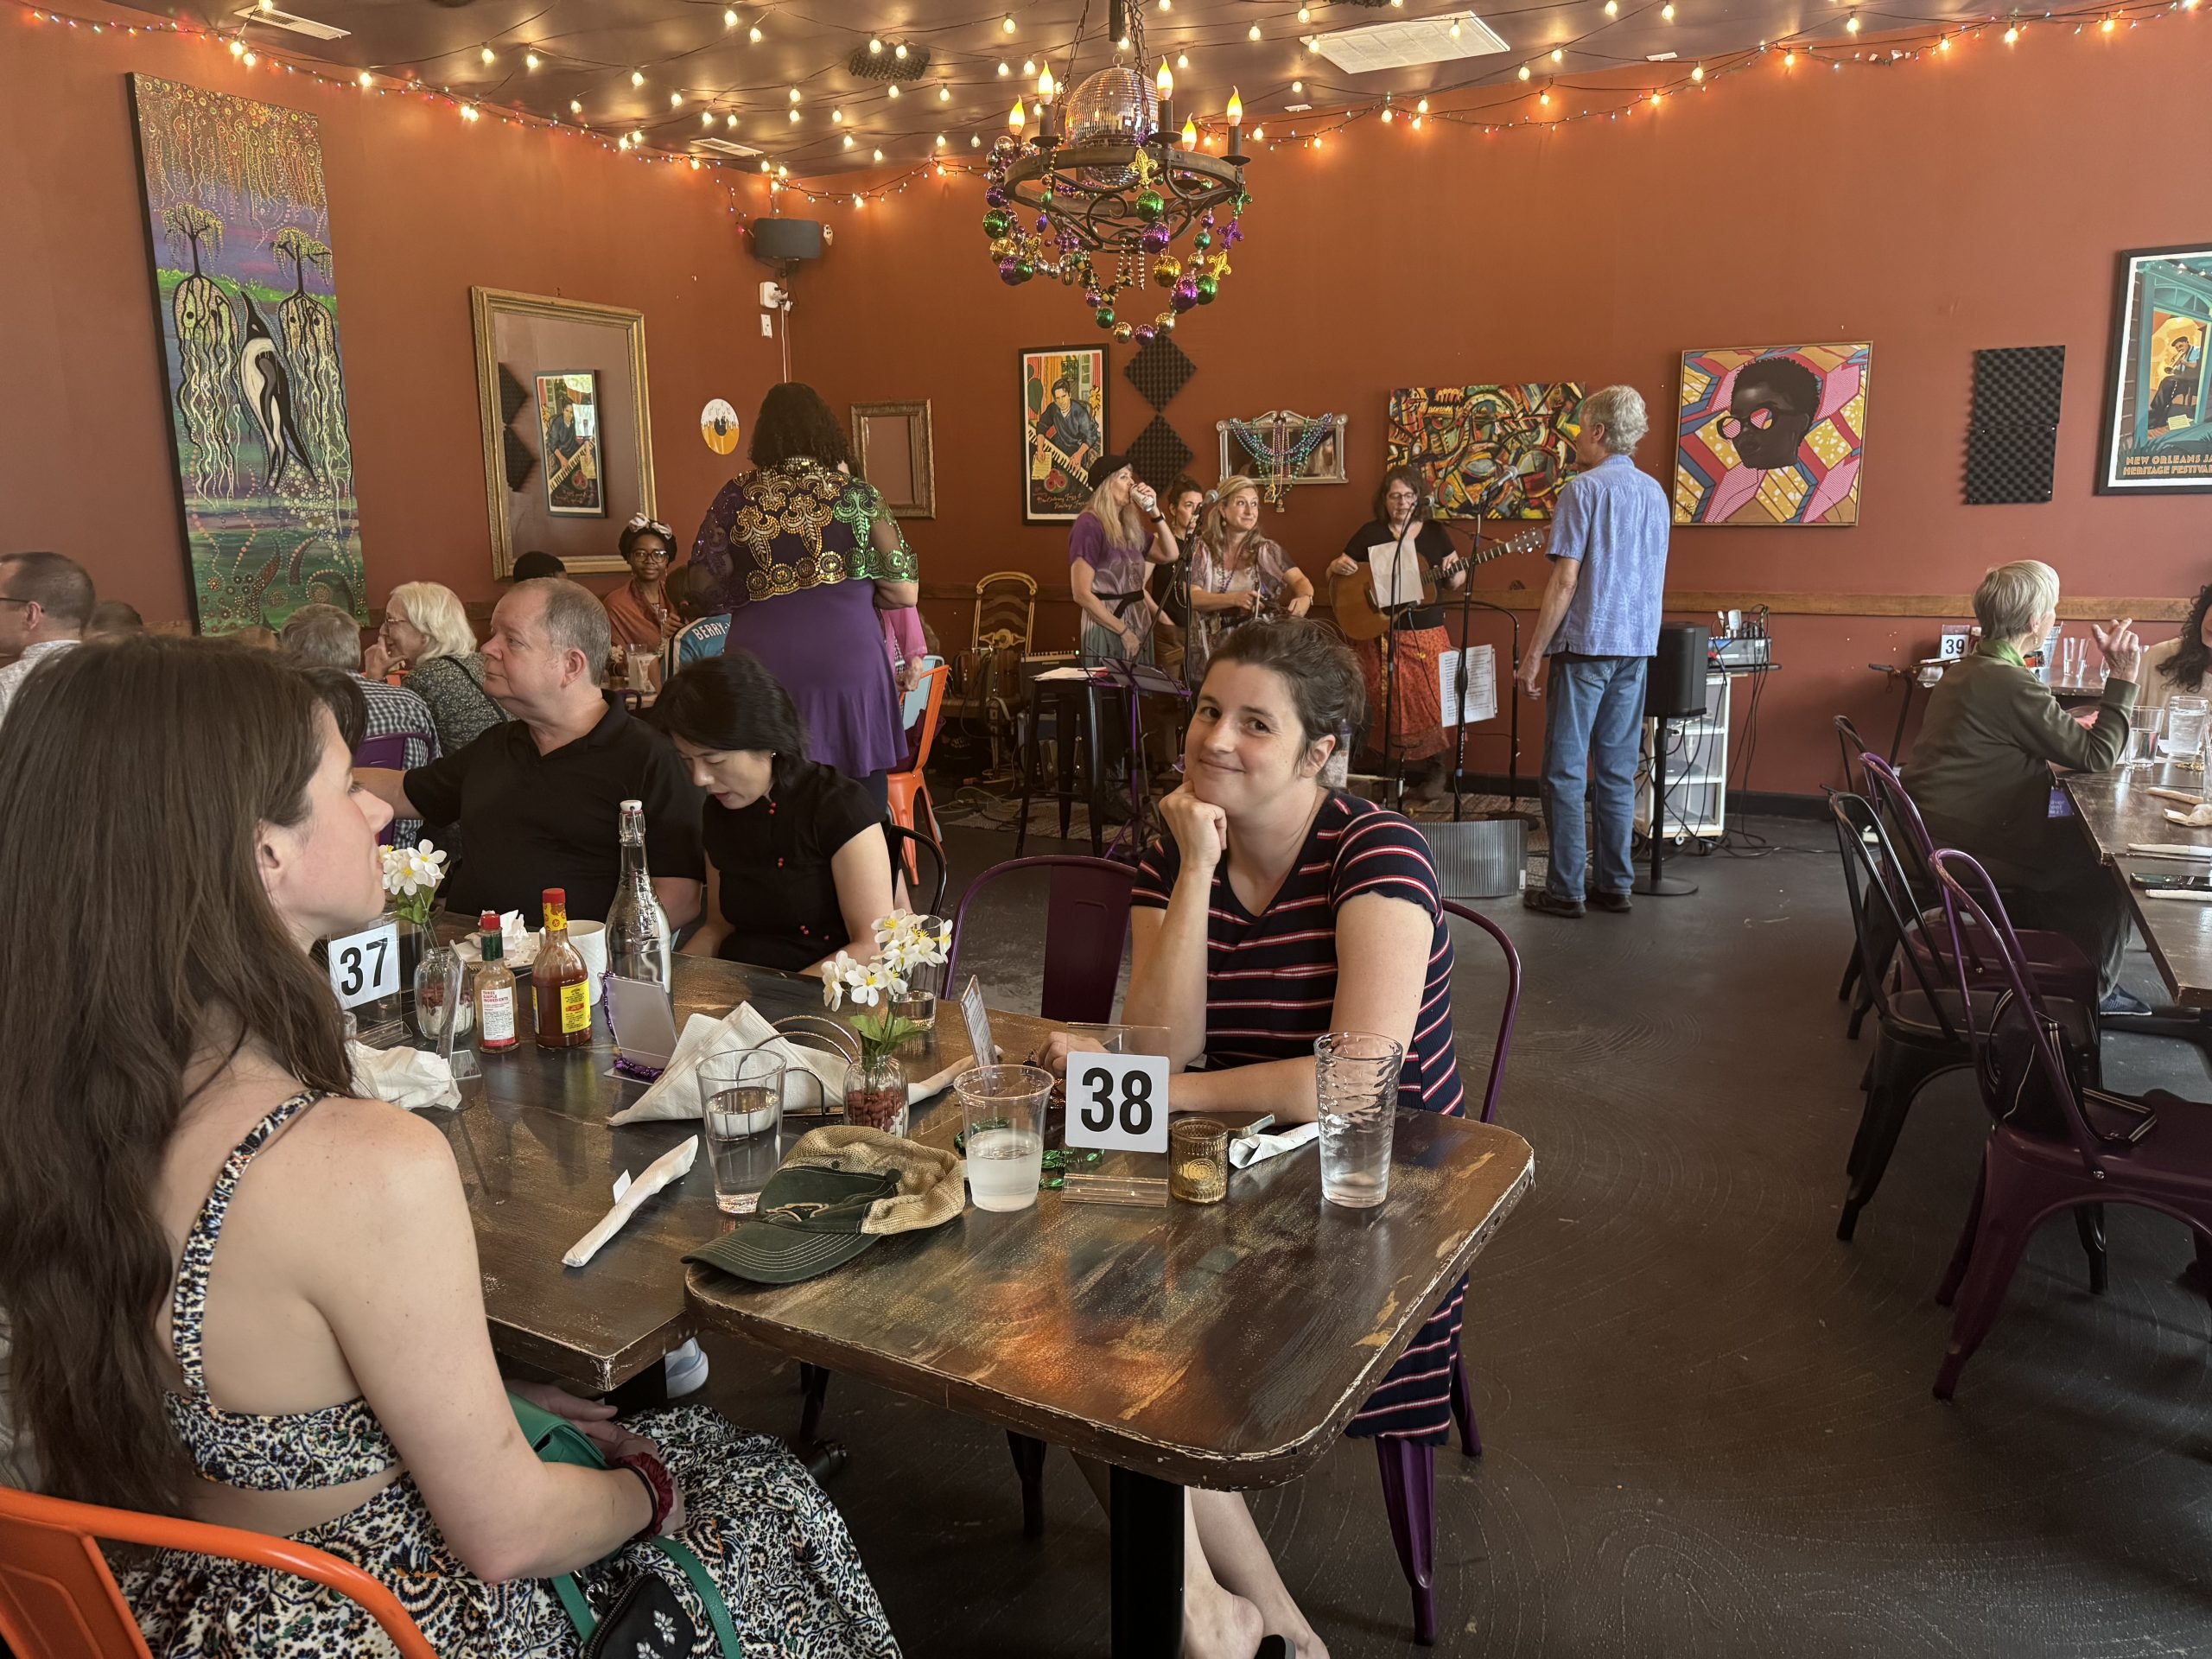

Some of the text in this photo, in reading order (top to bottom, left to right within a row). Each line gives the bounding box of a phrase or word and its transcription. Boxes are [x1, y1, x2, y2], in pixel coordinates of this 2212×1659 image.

[2126, 456, 2150, 466] NEW
[2152, 454, 2201, 465] ORLEANS
[2123, 466, 2170, 476] HERITAGE
[691, 622, 726, 640] BERRY
[1945, 639, 1965, 654] 39
[340, 938, 388, 996] 37
[1080, 1066, 1154, 1135] 38
